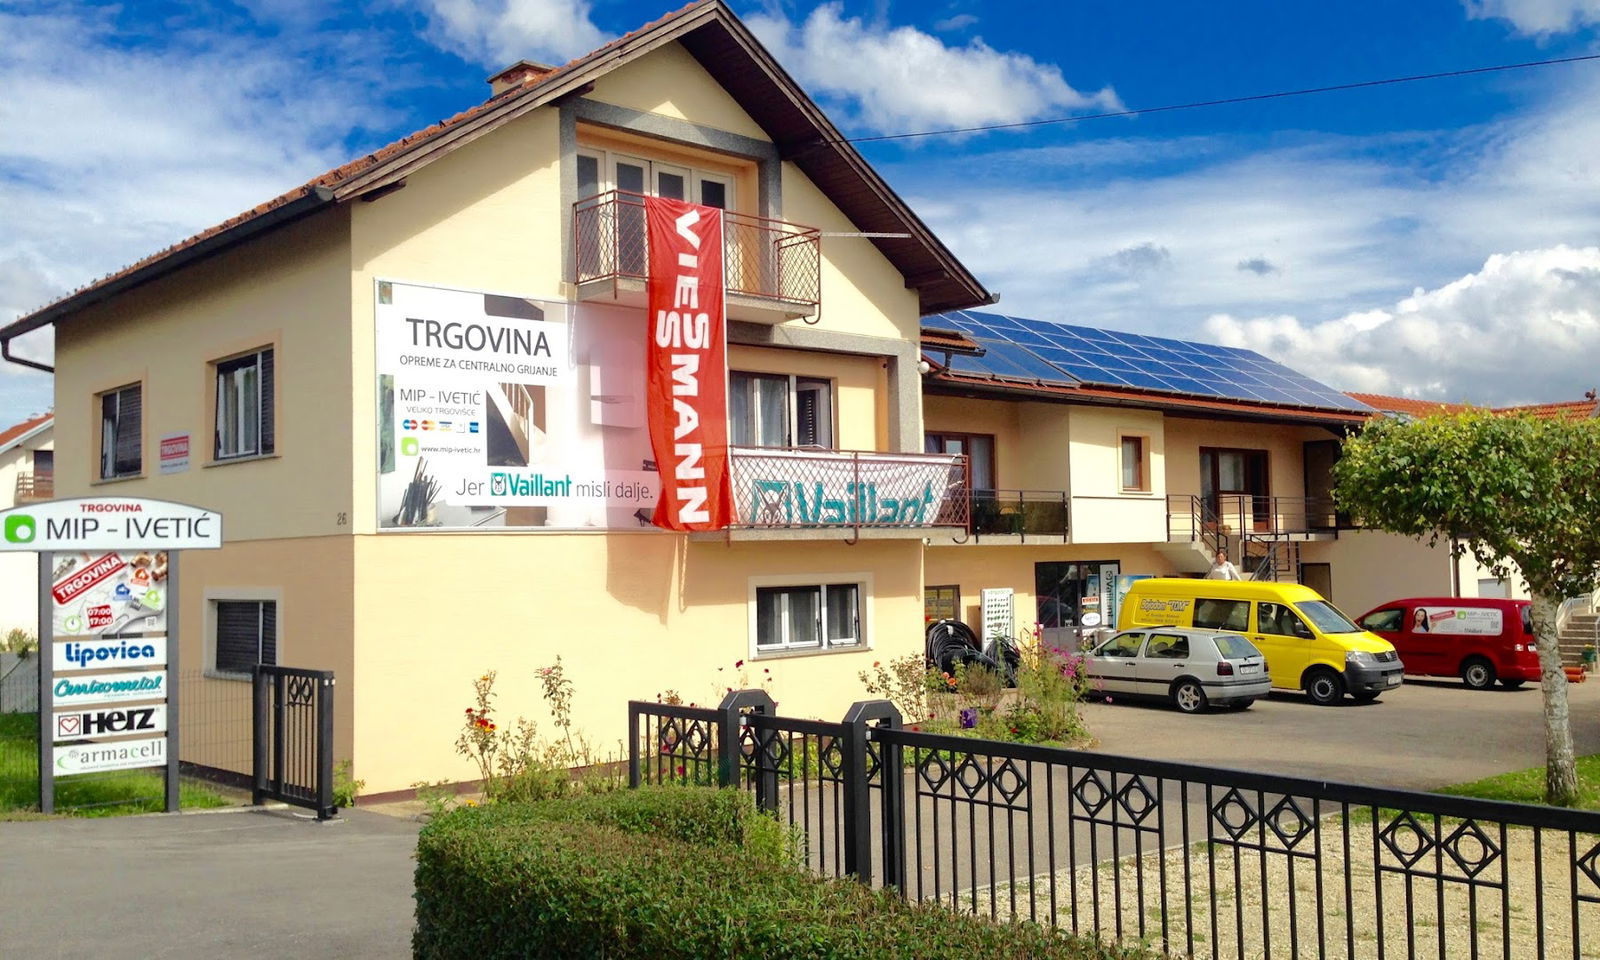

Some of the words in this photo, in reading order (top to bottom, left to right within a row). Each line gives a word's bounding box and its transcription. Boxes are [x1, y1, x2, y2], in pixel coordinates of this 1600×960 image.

[405, 317, 551, 357] TRGOVINA
[400, 355, 441, 368] OPREME
[443, 358, 456, 369] ZA
[458, 360, 515, 373] CENTRALNO
[517, 364, 558, 377] GRIJANJE
[400, 389, 426, 401] MIP
[438, 390, 481, 405] IVETIĆ
[406, 406, 433, 414] VELIKO
[421, 445, 481, 454] www.mip-ivetic.hr
[456, 478, 485, 496] Jer
[508, 473, 572, 498] Vaillant
[576, 481, 610, 498] misli
[615, 481, 653, 499] dalje.
[80, 503, 142, 513] TRGOVINA
[790, 481, 934, 525] Vaillant
[47, 518, 99, 540] MIP
[126, 513, 210, 539] IVETIĆ
[56, 556, 120, 598] TRGOVINA
[88, 608, 111, 616] 07:00
[90, 617, 113, 626] 17:00
[66, 641, 155, 667] Lipovica
[54, 675, 163, 697] Centrometal
[80, 741, 162, 763] armacell
